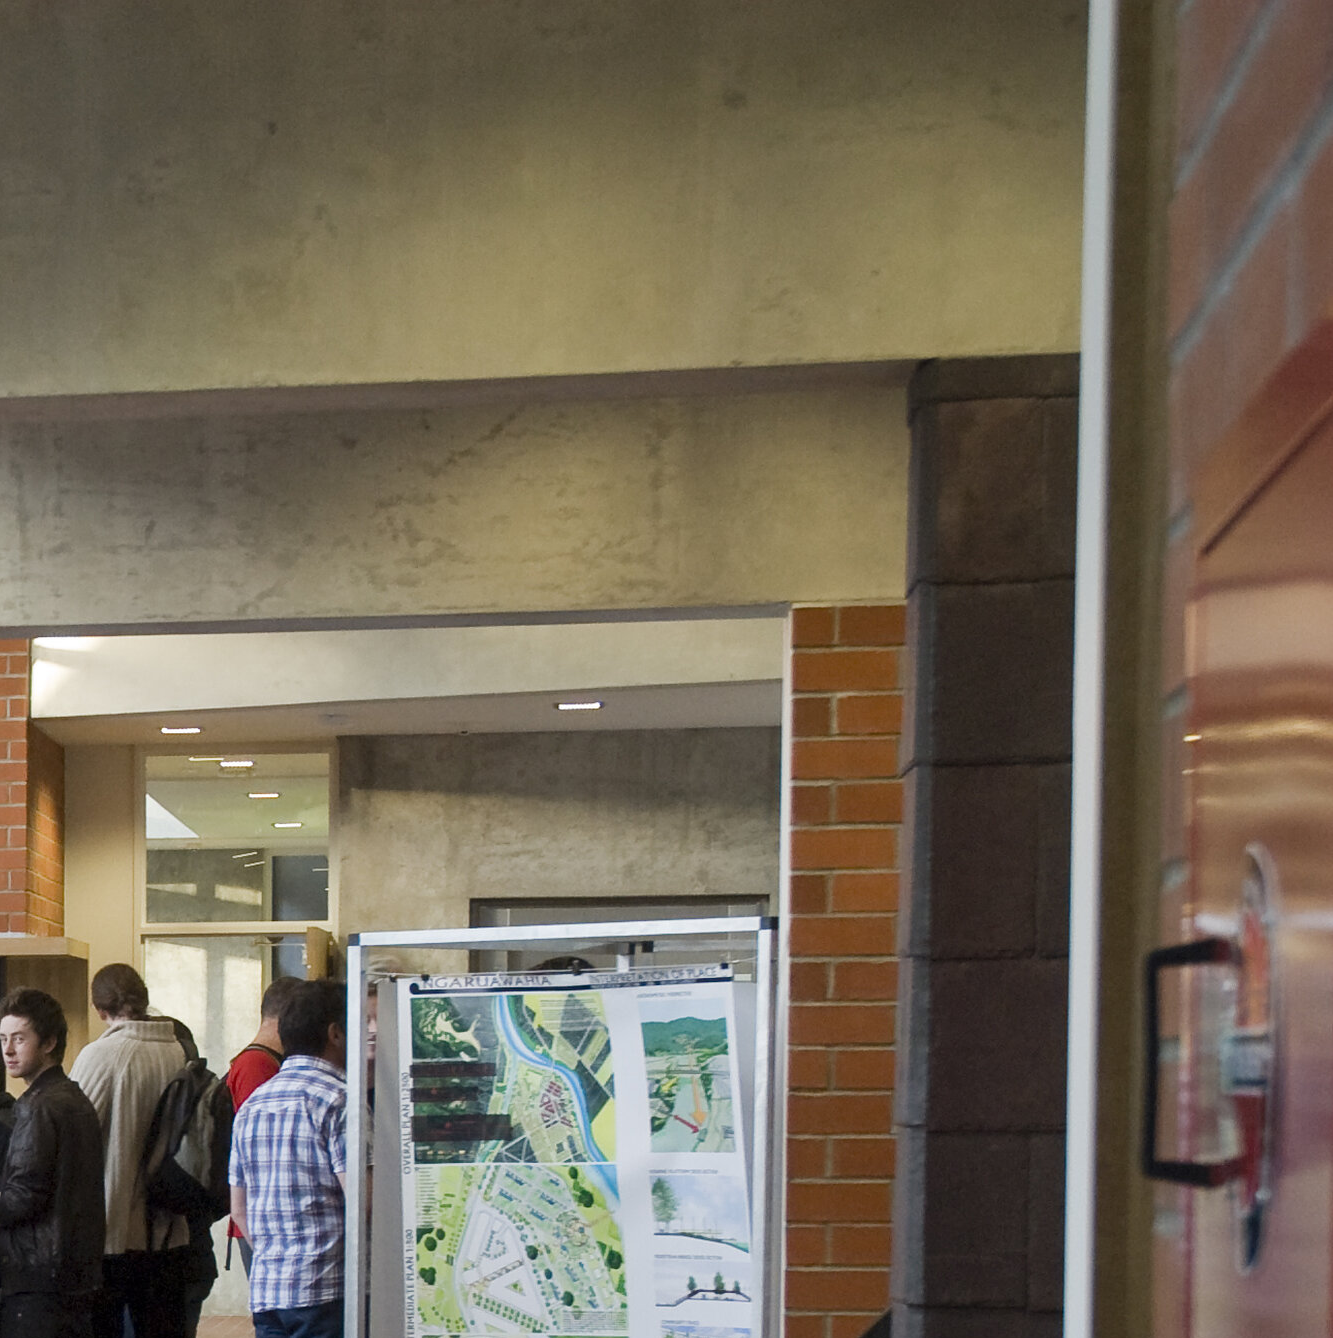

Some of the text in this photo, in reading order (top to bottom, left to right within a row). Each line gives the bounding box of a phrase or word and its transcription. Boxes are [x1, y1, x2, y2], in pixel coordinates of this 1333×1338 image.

[423, 976, 551, 989] NGARUAWAHIA
[671, 969, 684, 979] OF
[687, 966, 718, 978] PLACE
[401, 1104, 411, 1129] PLAN
[402, 1131, 412, 1175] OVERALL
[405, 1256, 414, 1281] PLAN
